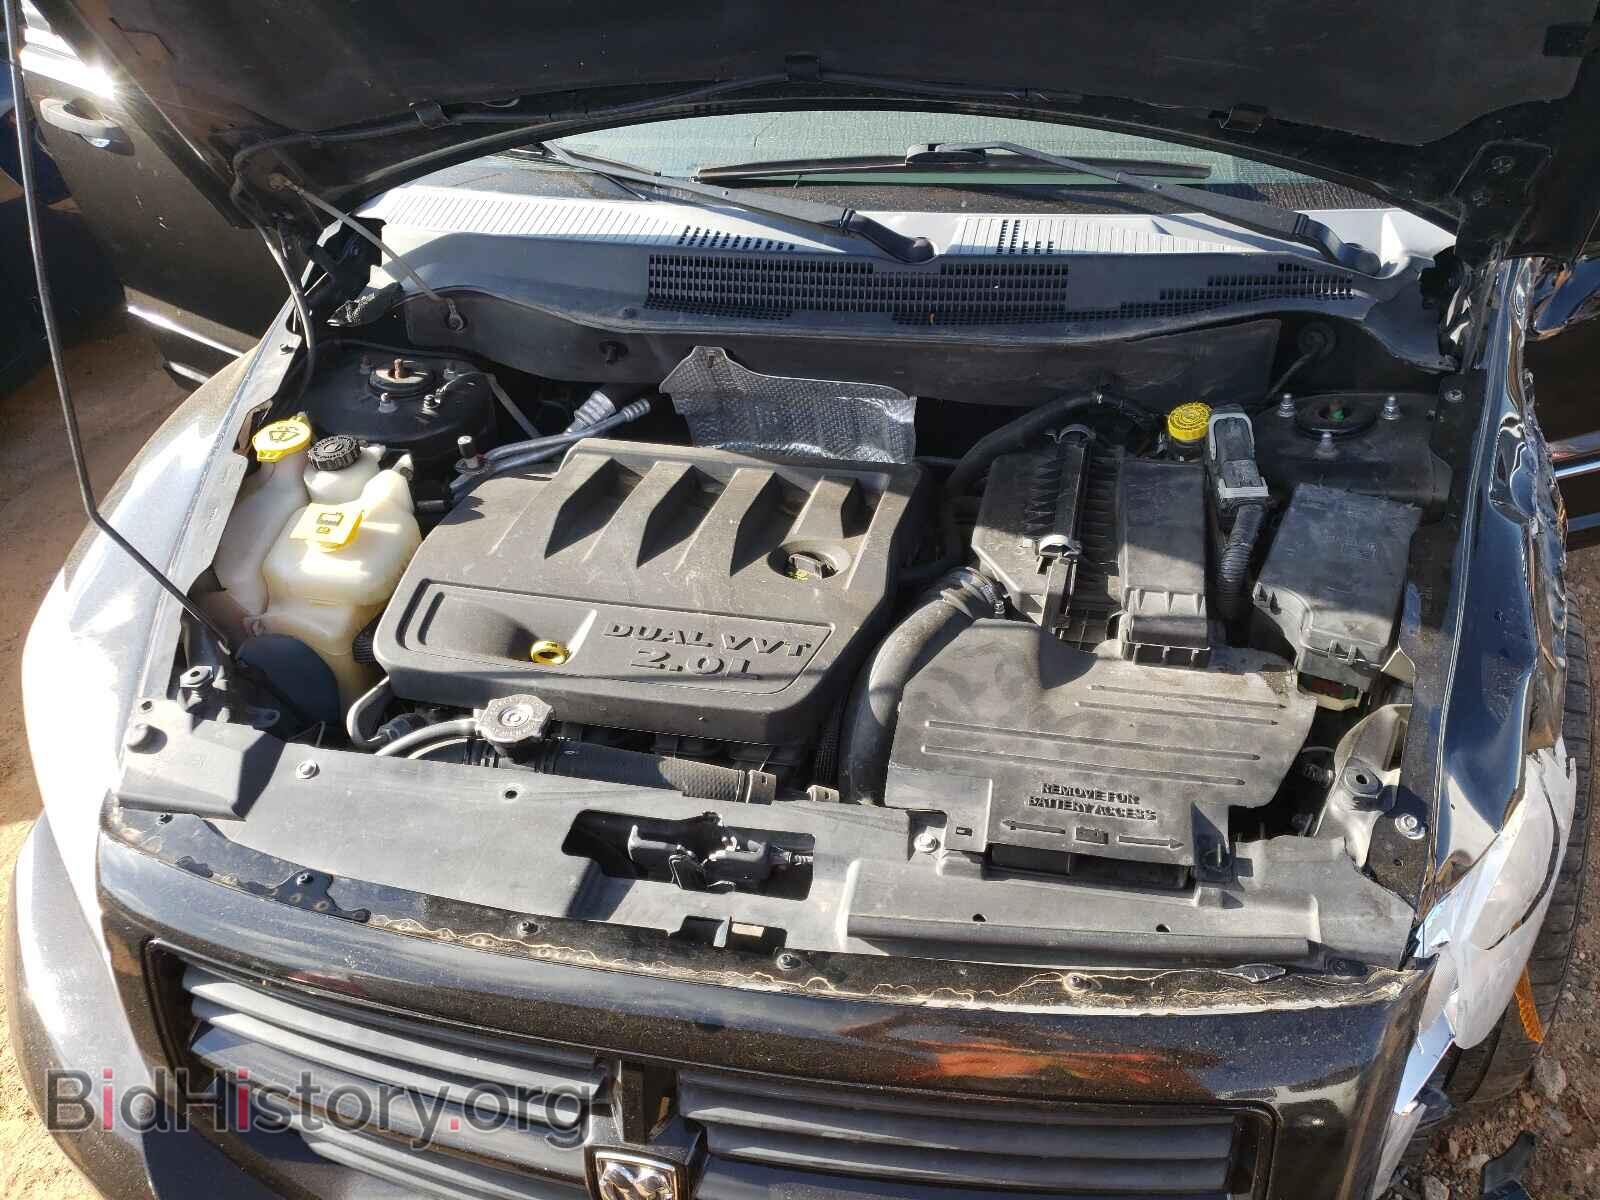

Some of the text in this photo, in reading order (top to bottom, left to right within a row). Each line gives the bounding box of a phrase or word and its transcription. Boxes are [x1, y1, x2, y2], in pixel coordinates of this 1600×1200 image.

[604, 622, 812, 657] DUAL VVT
[631, 648, 760, 681] 2.0L
[1025, 795, 1157, 822] BATTERY ACCESS
[1041, 783, 1140, 805] REMOVE FOR
